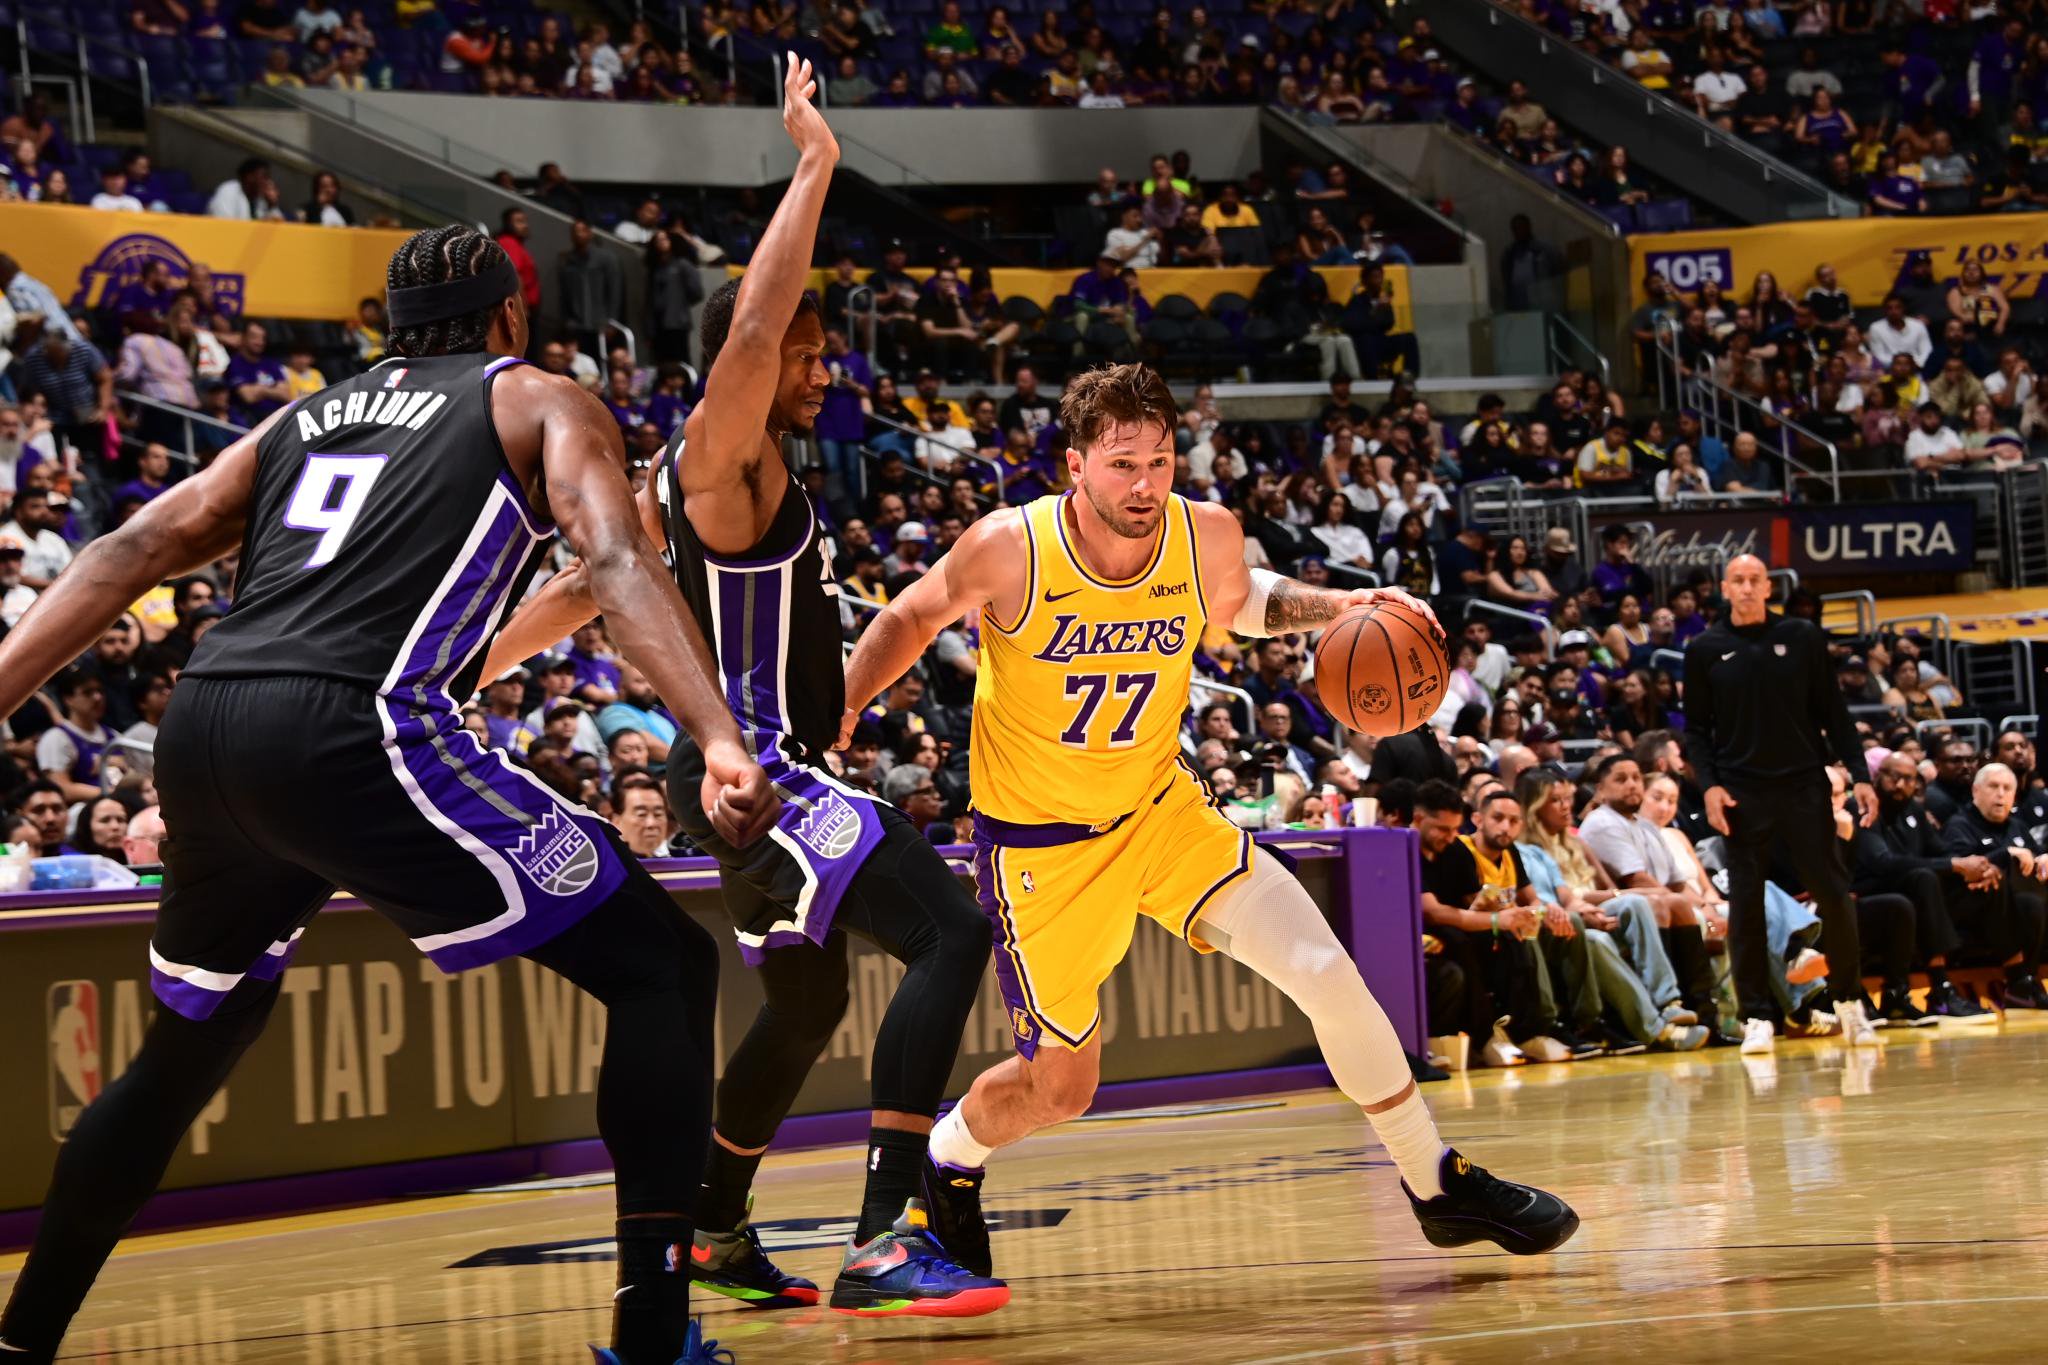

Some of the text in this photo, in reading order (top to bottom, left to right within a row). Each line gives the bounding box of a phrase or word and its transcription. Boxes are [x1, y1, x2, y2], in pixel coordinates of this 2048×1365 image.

[1654, 254, 1723, 287] 105
[297, 391, 447, 442] ACHIUWA
[283, 453, 389, 569] 9
[1805, 521, 1956, 561] ULTRA
[1148, 582, 1188, 598] Albert
[1032, 614, 1187, 664] LAKERS
[1060, 672, 1158, 747] 77
[525, 822, 572, 868] SACRAMENTO
[812, 805, 853, 852] KINGS
[530, 829, 587, 884] KINGS
[280, 960, 406, 1124] TAP
[420, 957, 504, 1109] TO
